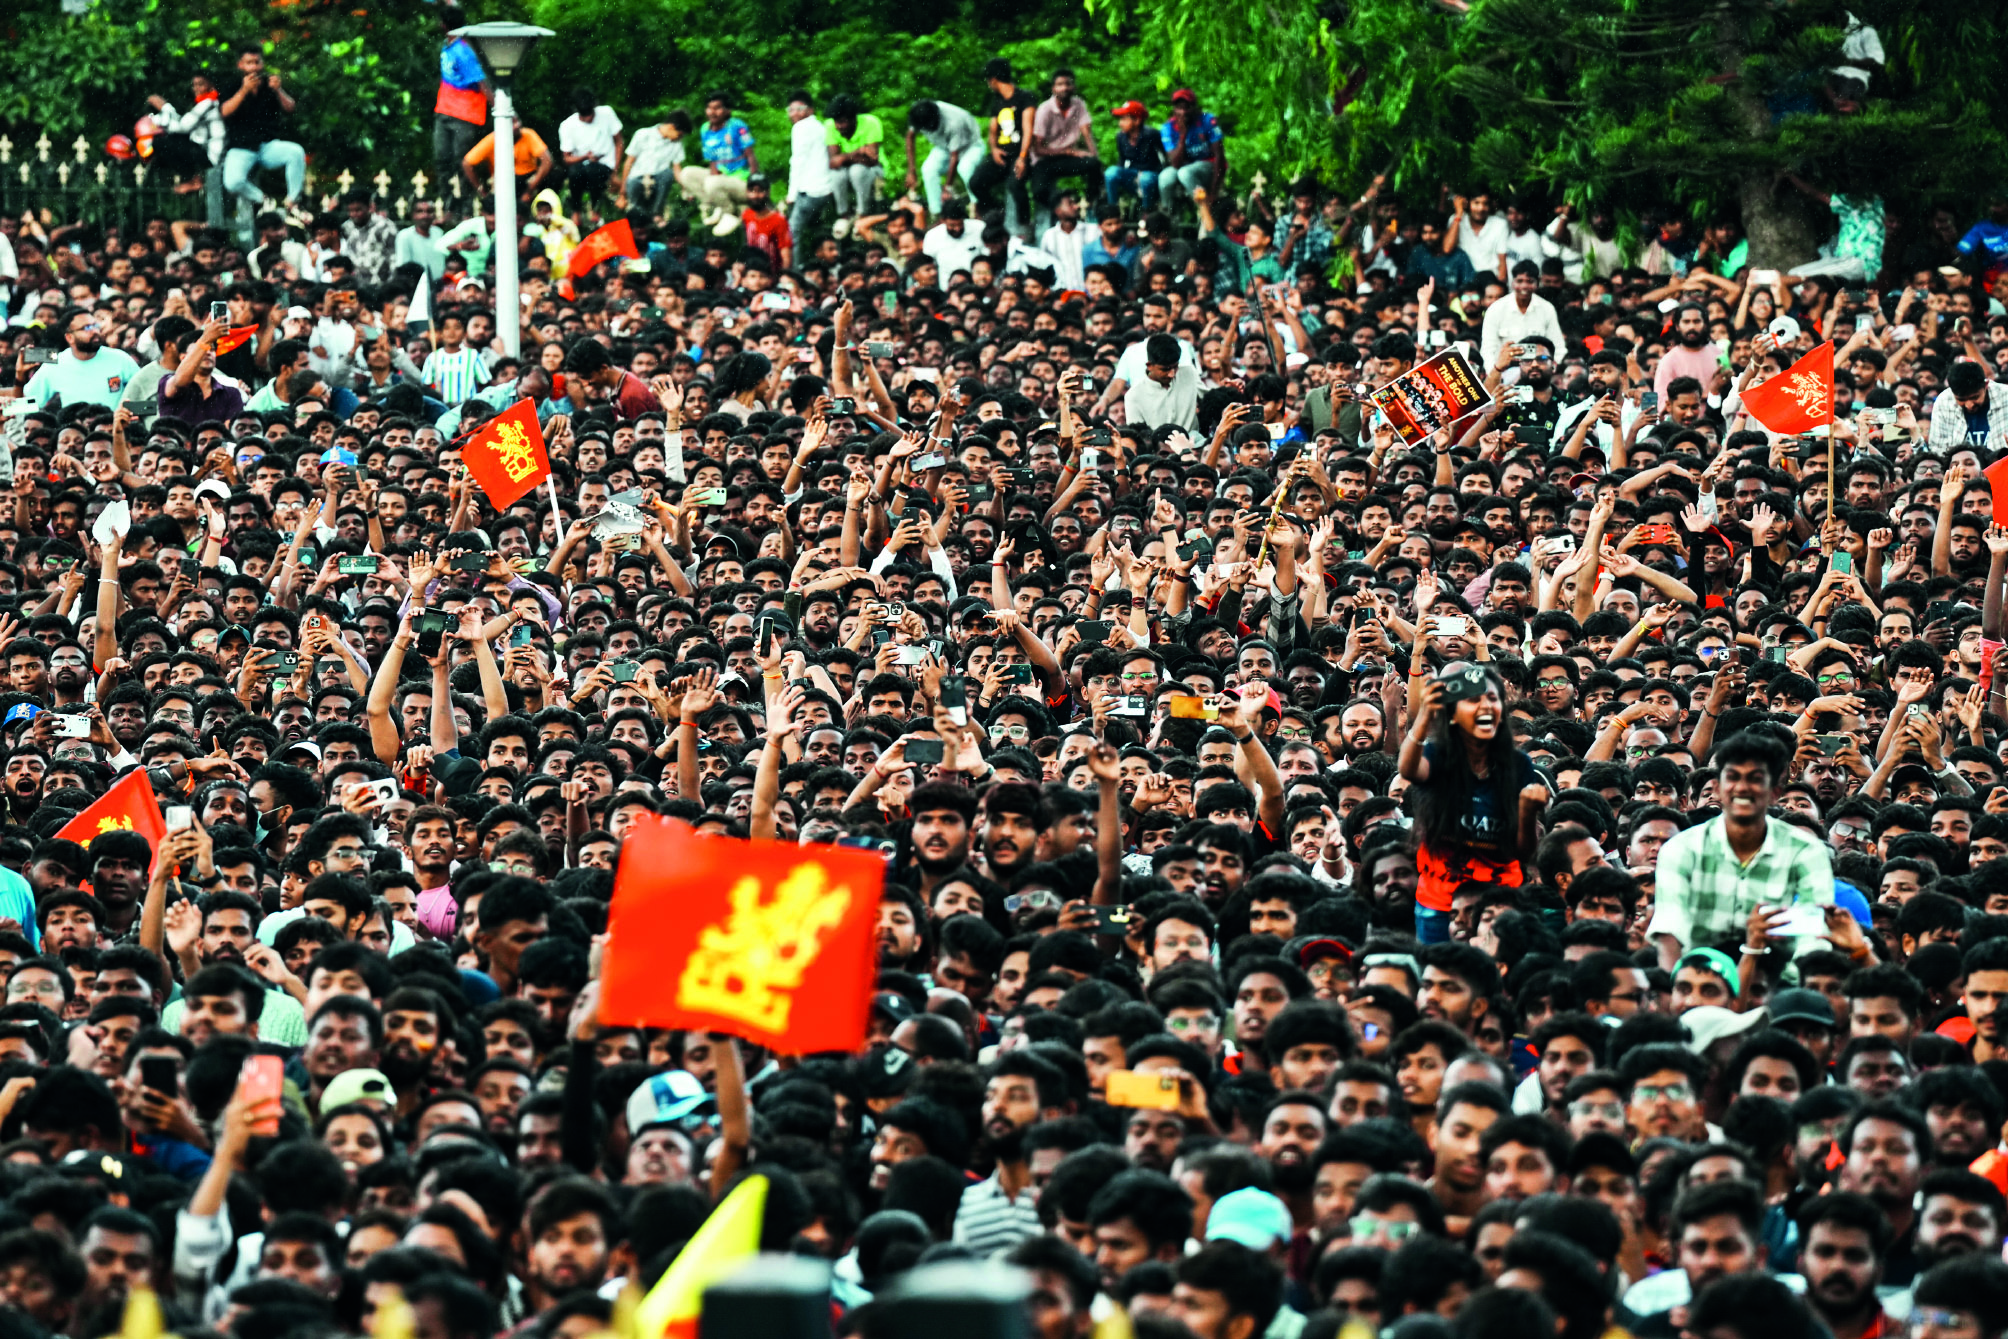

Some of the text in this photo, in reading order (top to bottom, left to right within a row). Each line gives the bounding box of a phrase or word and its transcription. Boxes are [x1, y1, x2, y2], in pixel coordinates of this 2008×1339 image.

[1438, 364, 1453, 383] THE
[1449, 382, 1468, 405] BOLD
[1448, 357, 1480, 401] ANOTHER ONE
